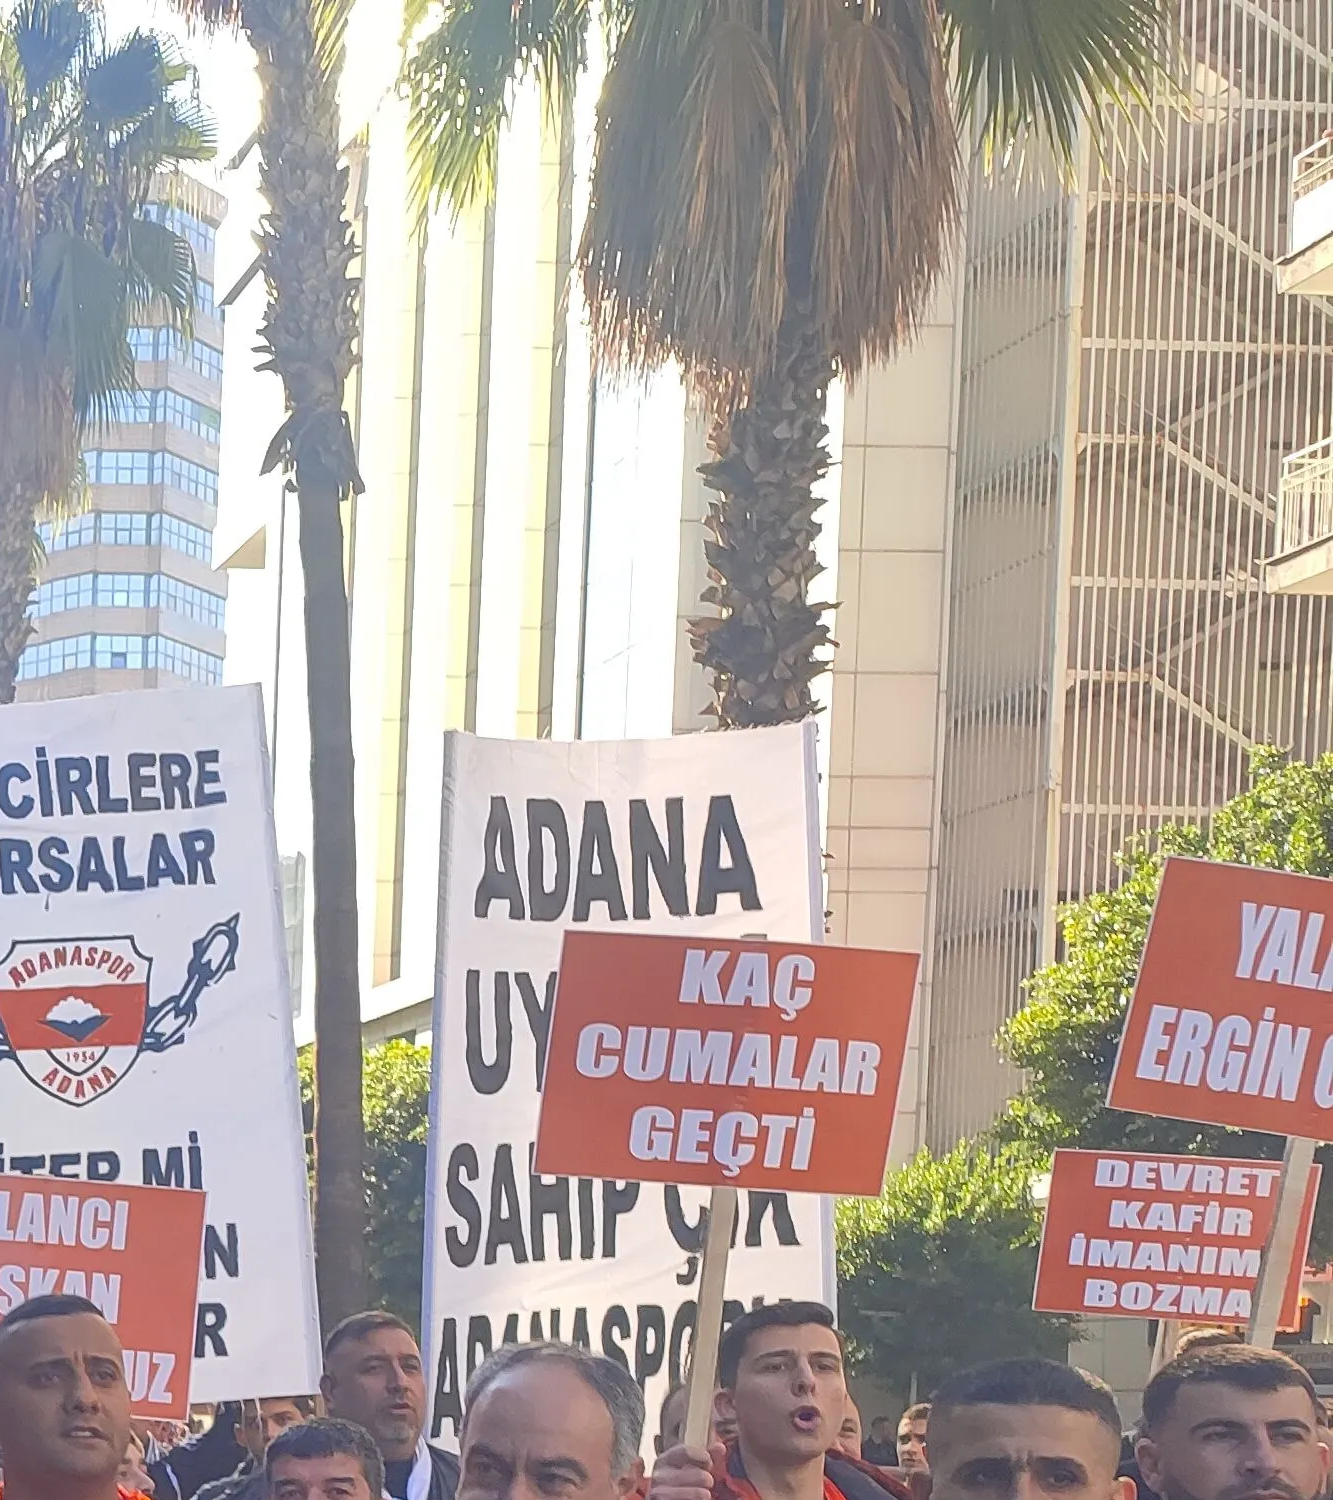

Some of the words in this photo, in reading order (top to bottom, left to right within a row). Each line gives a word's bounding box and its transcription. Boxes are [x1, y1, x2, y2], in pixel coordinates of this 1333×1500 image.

[474, 795, 763, 921] ADANA
[8, 945, 135, 988] ADANASPOR
[679, 948, 815, 1021] KAÇ
[42, 1064, 117, 1098] ADANA
[576, 1023, 882, 1096] CUMALAR
[1136, 1003, 1311, 1102] ERGİN
[629, 1106, 815, 1177] GEÇTİ
[1094, 1158, 1280, 1197] DEVRET
[1108, 1199, 1254, 1238] KAFİR
[1084, 1278, 1253, 1319] BOZMA
